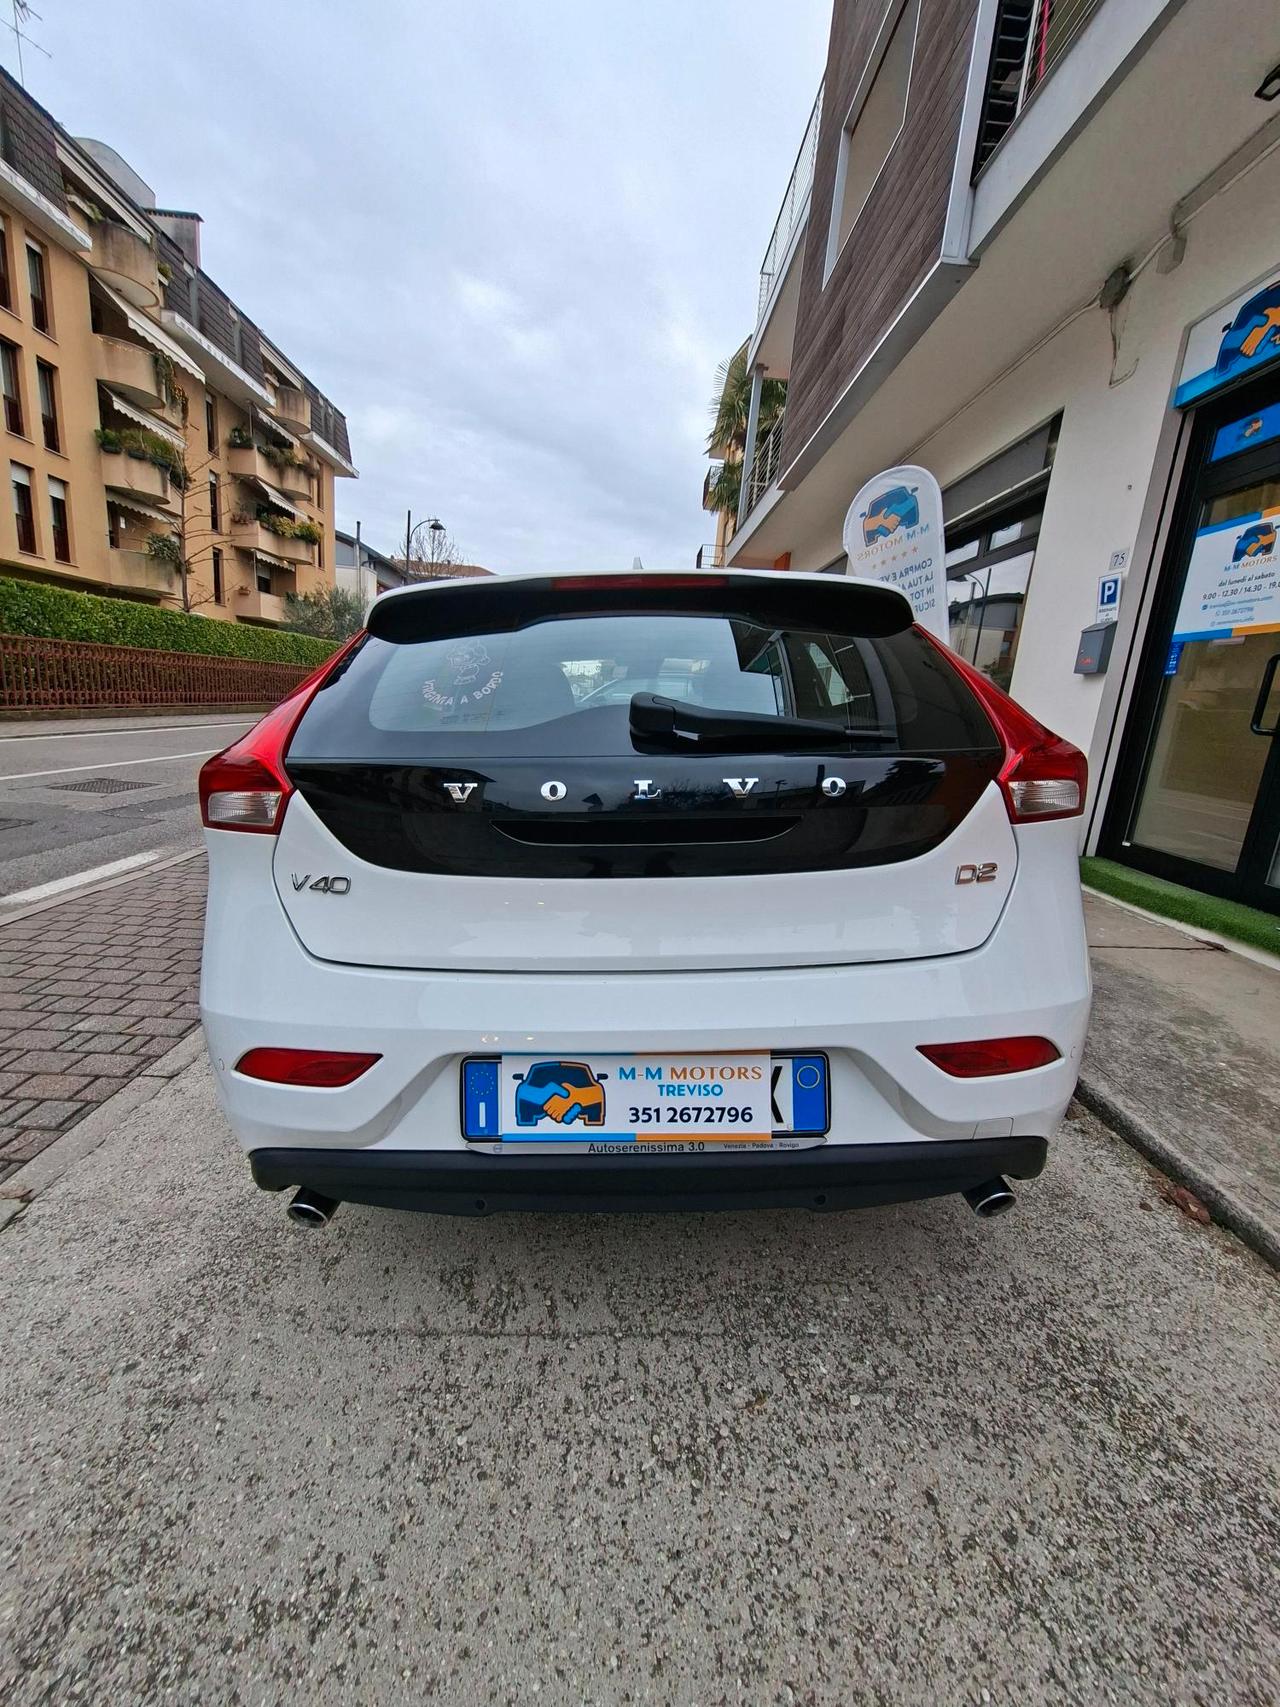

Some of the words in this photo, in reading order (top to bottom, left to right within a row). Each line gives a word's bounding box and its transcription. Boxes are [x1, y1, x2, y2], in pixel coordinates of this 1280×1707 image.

[1113, 552, 1125, 566] 75
[1240, 555, 1278, 569] MOTORS
[1104, 581, 1115, 603] P
[1202, 592, 1216, 601] 9.00
[1222, 587, 1239, 599] 12.30
[1244, 584, 1263, 594] 14.30
[460, 695, 469, 705] A
[443, 776, 847, 804] VOLVO
[954, 862, 998, 886] D2
[290, 872, 352, 896] V40
[618, 1066, 663, 1081] M-M
[670, 1065, 763, 1080] MOTORS
[657, 1083, 724, 1097] TREVISO
[628, 1106, 661, 1124] 351
[666, 1106, 754, 1124] 2672796
[588, 1142, 684, 1154] Autoserenissima
[688, 1141, 705, 1153] 3.0
[723, 1142, 747, 1150] Venezia
[751, 1142, 774, 1150] Padova
